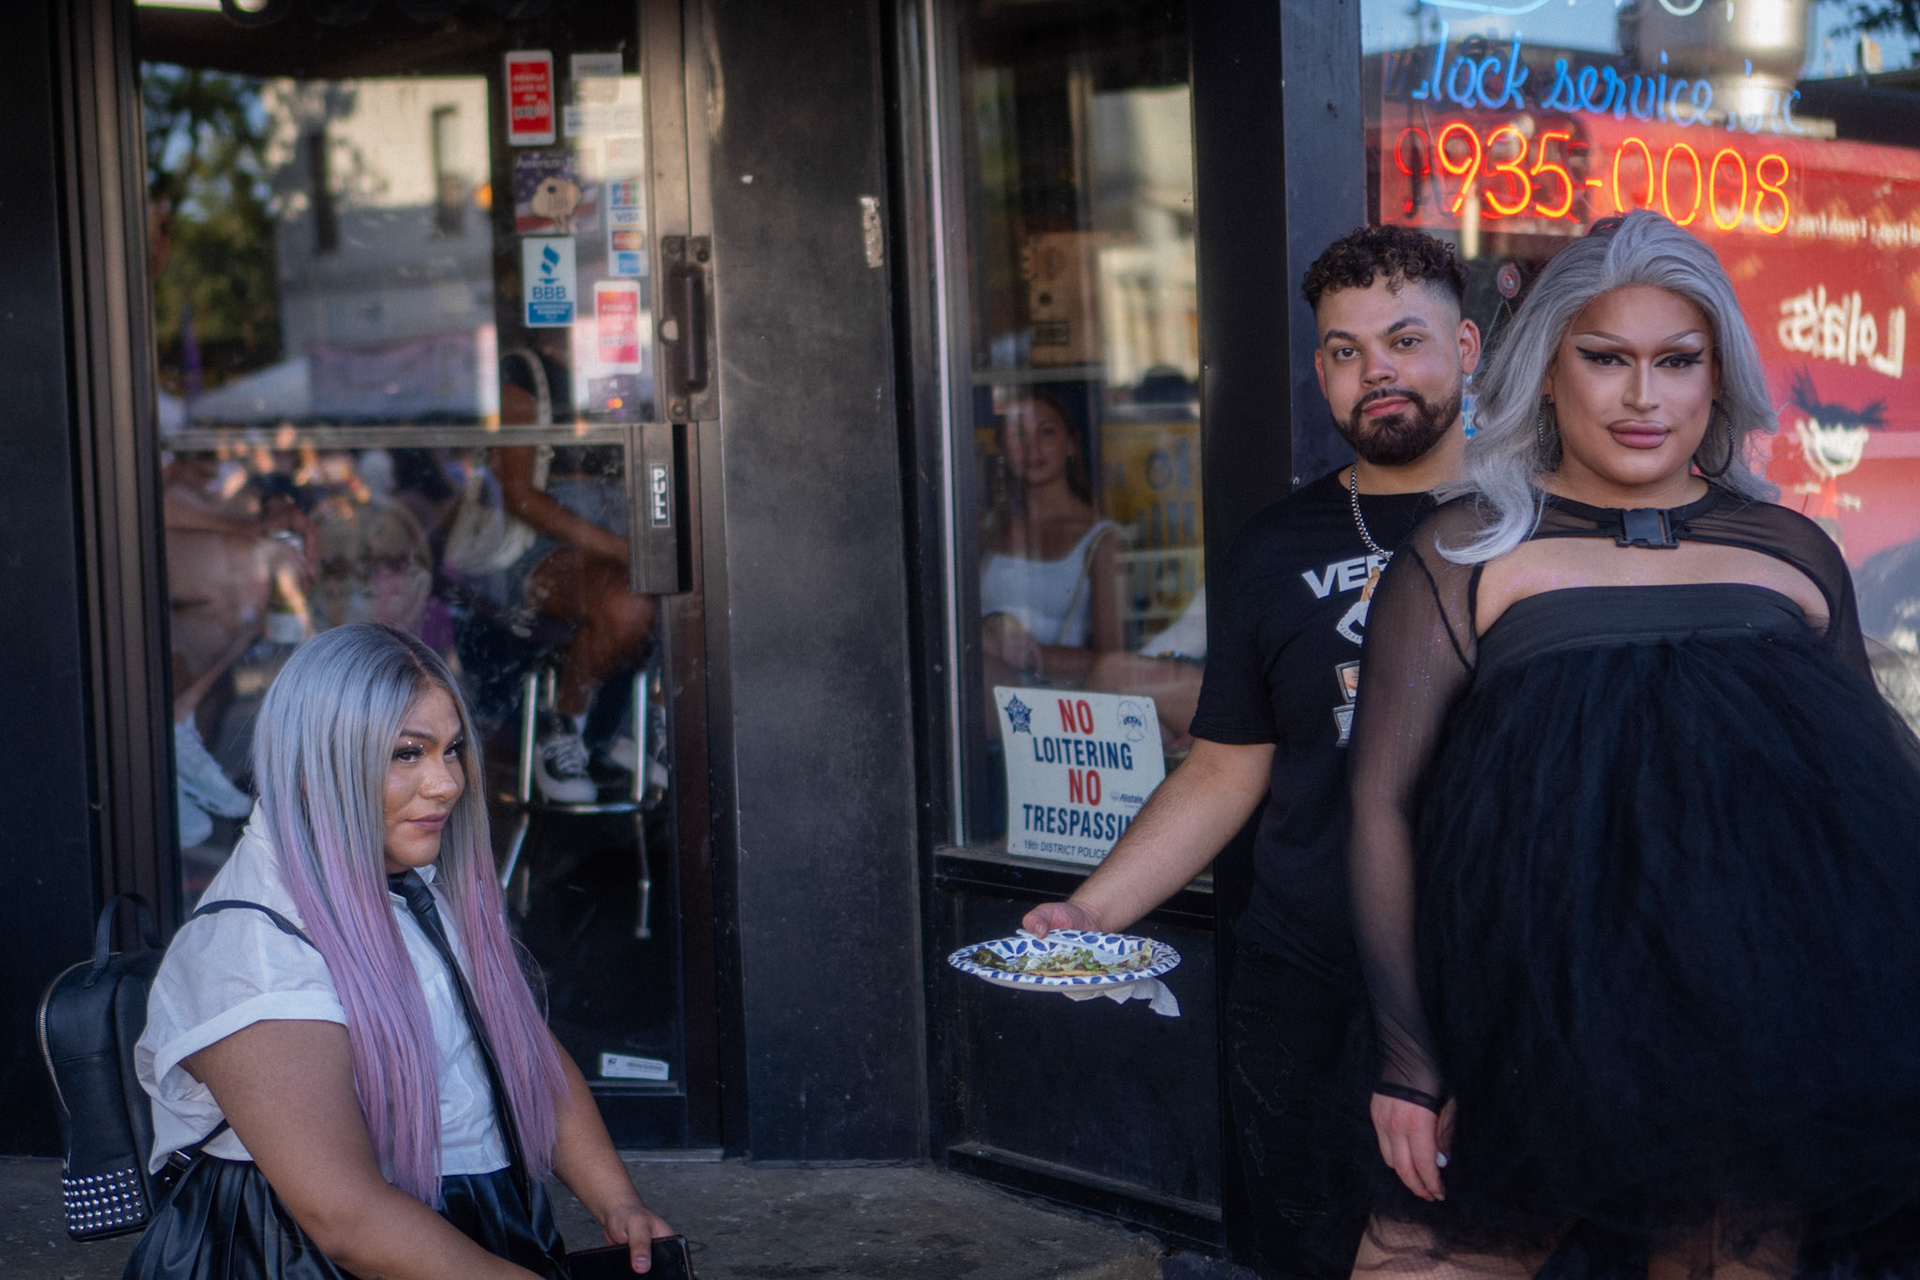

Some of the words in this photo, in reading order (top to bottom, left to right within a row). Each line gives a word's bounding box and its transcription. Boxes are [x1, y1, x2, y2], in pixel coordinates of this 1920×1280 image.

[1431, 21, 1528, 110] lock
[1541, 50, 1714, 126] service
[1437, 121, 1790, 234] 935-0008
[532, 286, 566, 300] BBB
[653, 467, 666, 520] PULL
[1058, 699, 1094, 735] NO
[1033, 736, 1133, 771] LOITERING
[1068, 768, 1102, 806] NO
[1024, 839, 1039, 851] 19th
[1041, 841, 1075, 856] DISTRICT
[1077, 846, 1107, 860] POLICE
